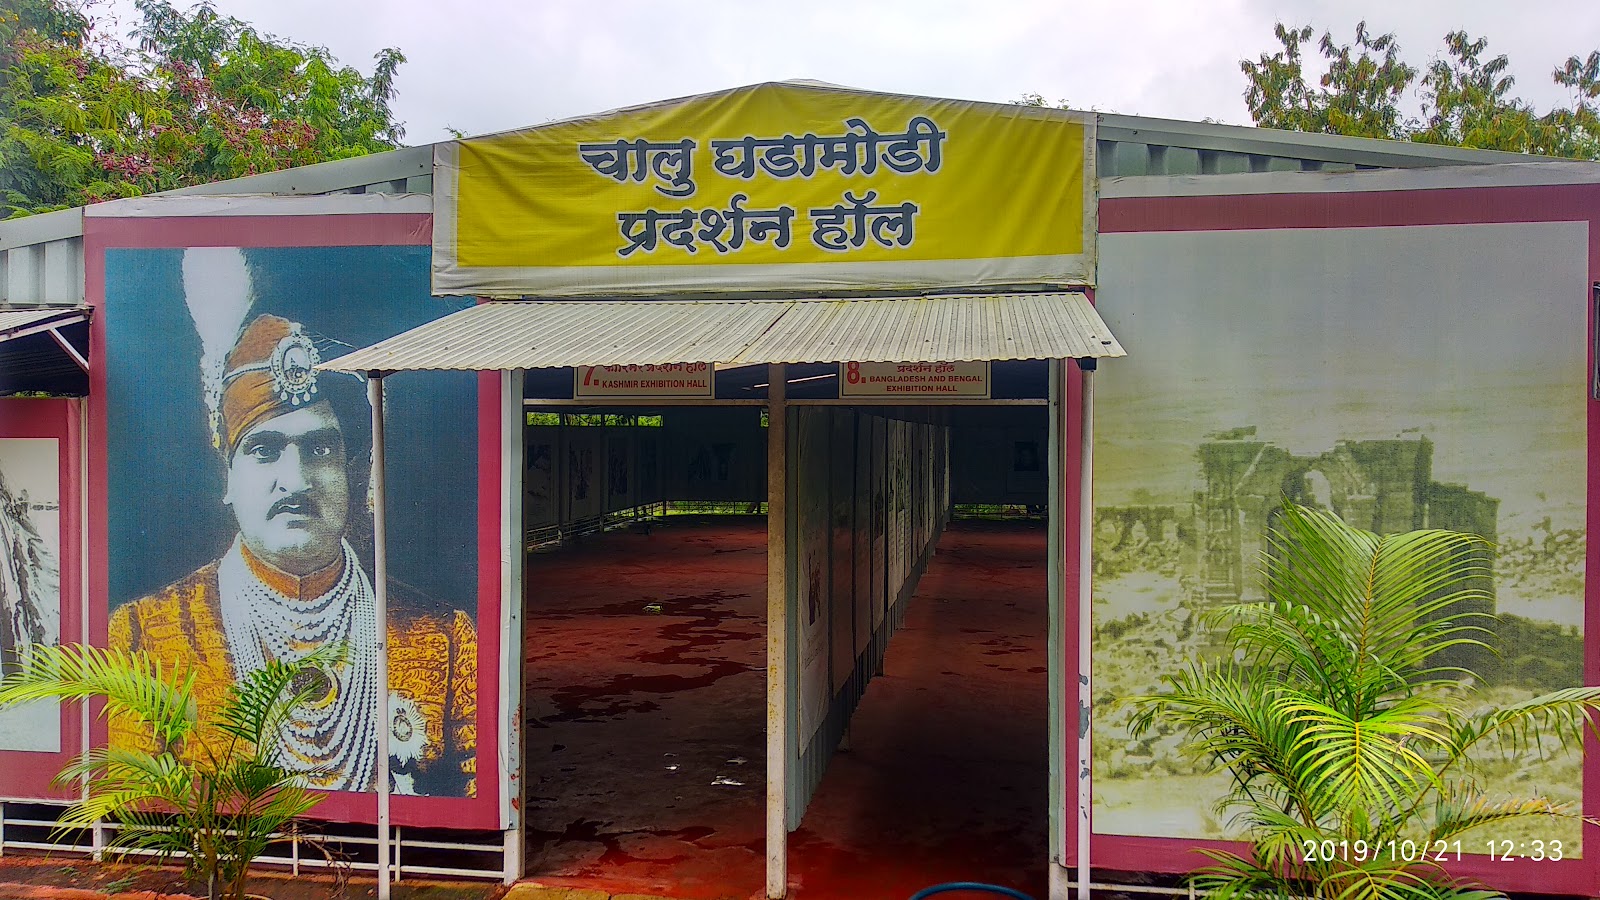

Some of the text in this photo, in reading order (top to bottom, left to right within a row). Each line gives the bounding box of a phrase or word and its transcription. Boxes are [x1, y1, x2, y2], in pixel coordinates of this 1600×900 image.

[579, 116, 946, 197] चालु घडामोडी
[618, 190, 918, 256] प्रदर्शन हॉल
[897, 362, 933, 373] प्रदर्शन
[602, 379, 707, 389] KASHMIR EXHIBITION HALL
[869, 375, 983, 383] BANGLADESH AND BENGAL
